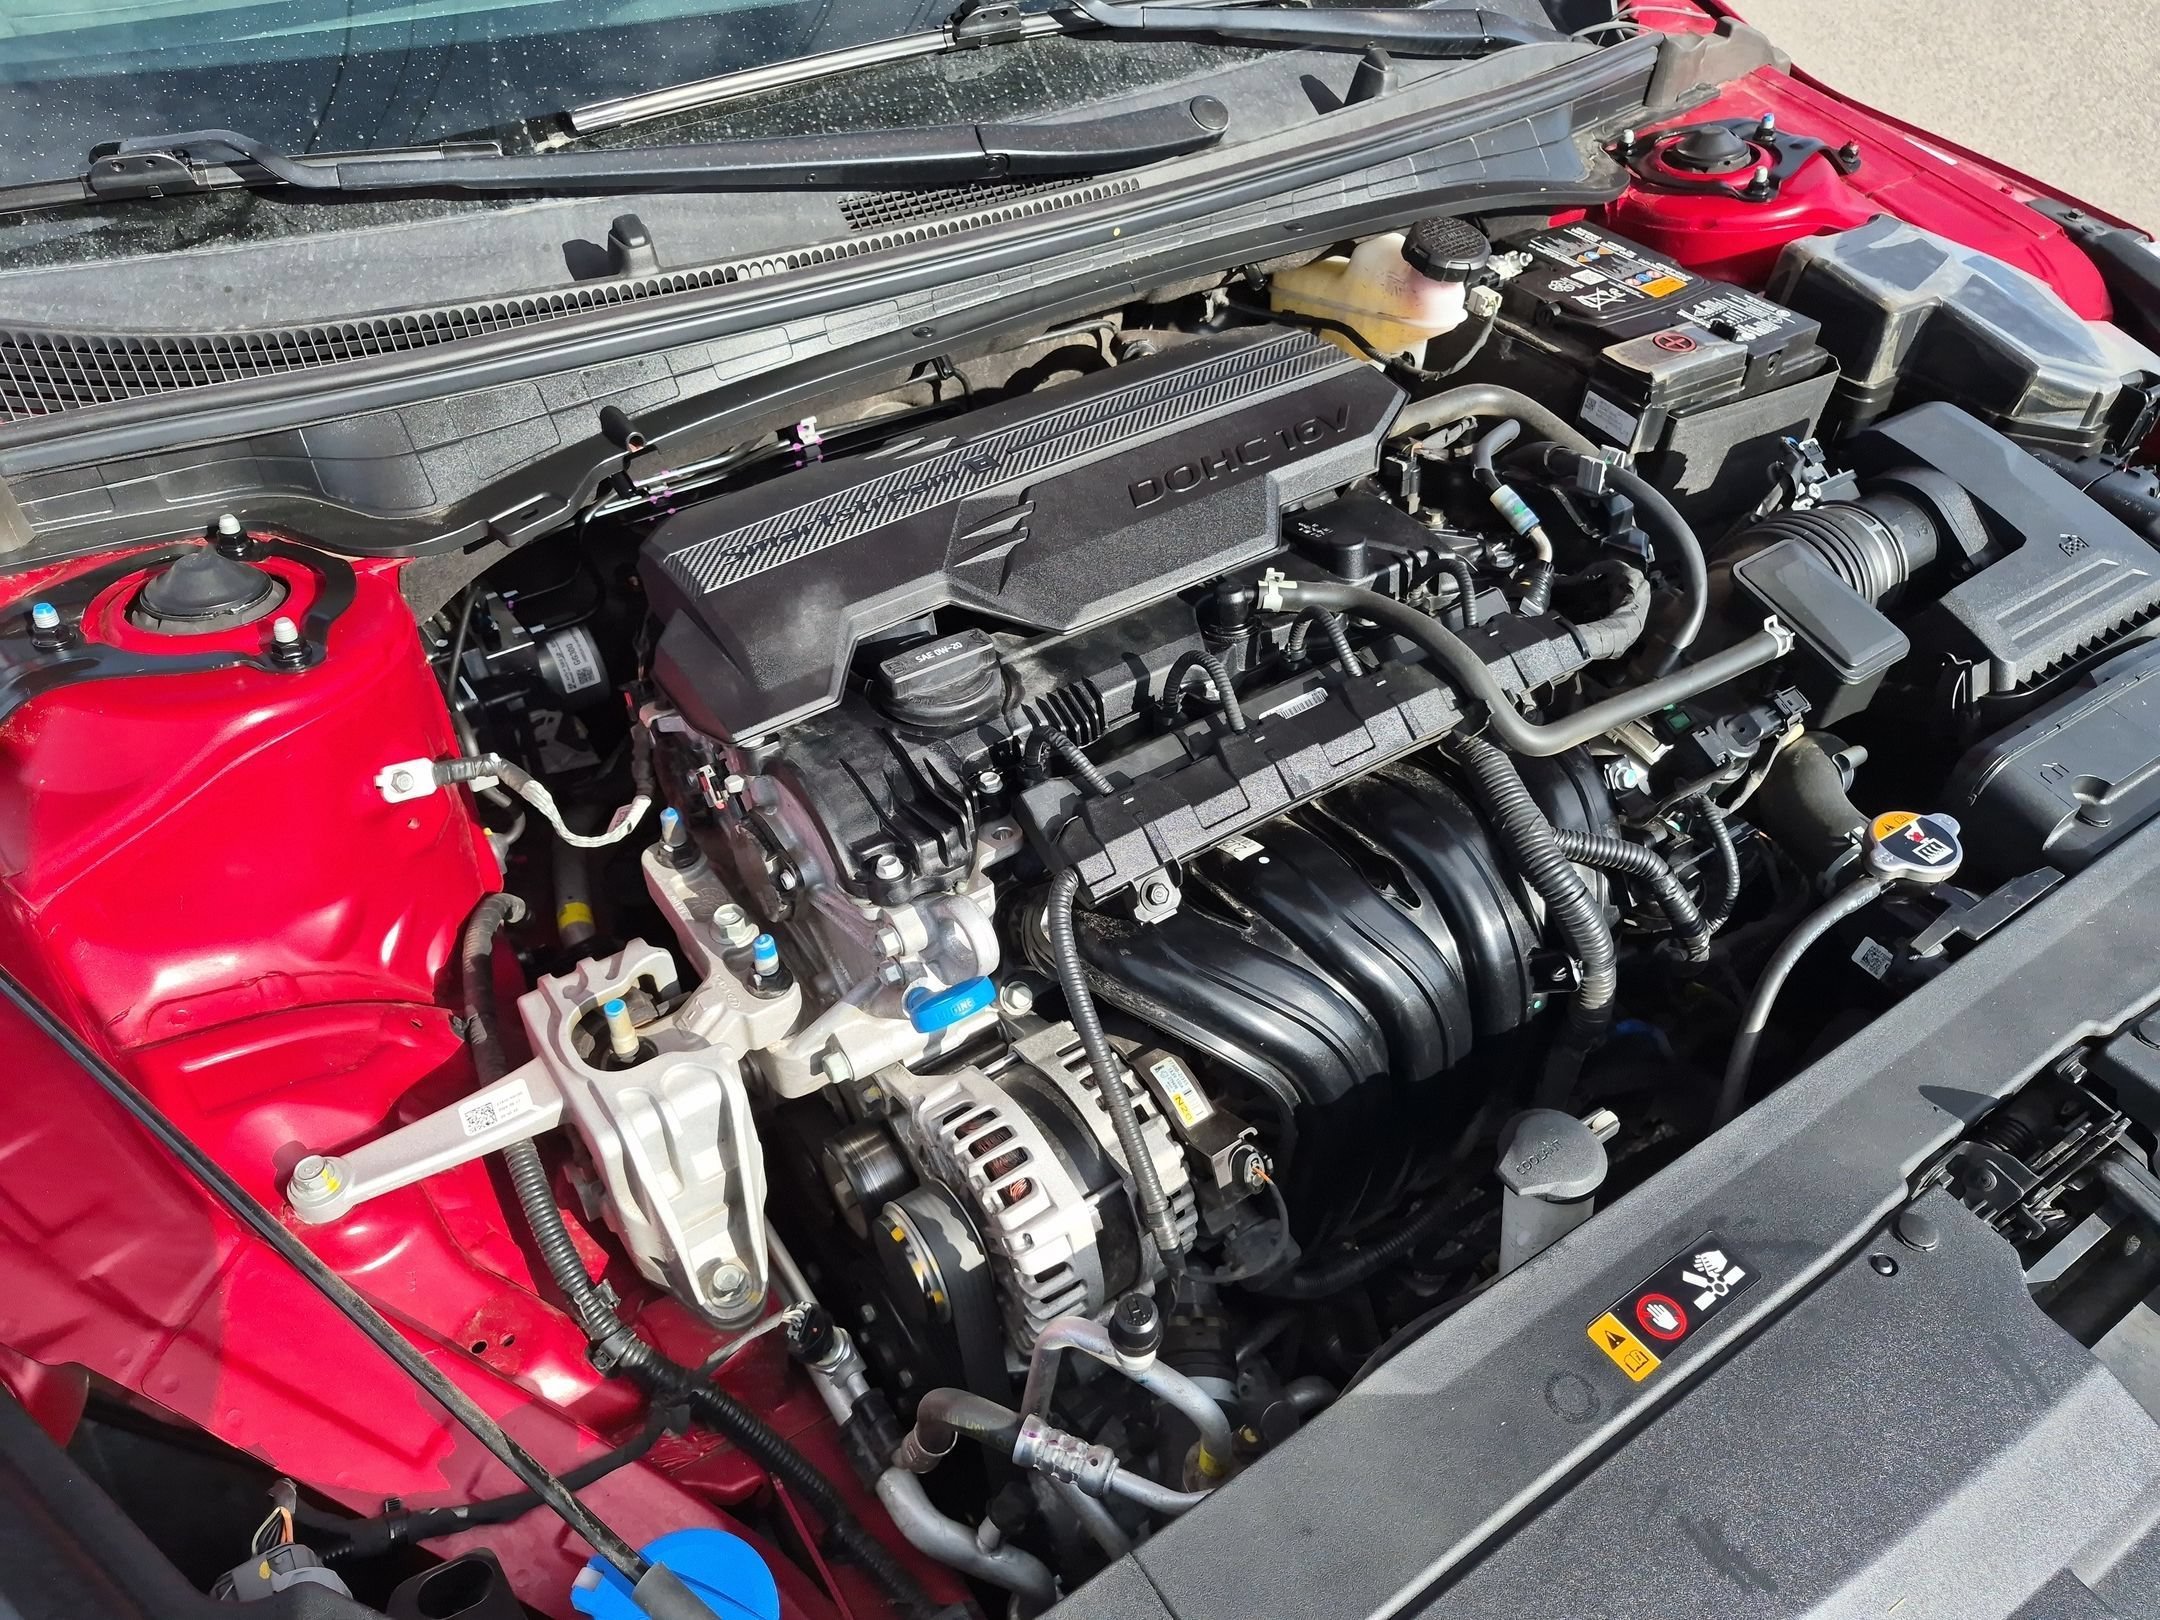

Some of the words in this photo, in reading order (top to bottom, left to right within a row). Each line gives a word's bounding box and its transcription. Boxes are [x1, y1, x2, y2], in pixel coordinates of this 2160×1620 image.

[1128, 437, 1272, 510] DOHC
[1274, 404, 1350, 451] 16V
[720, 469, 961, 565] Smartstream
[914, 652, 936, 663] SAE
[934, 641, 963, 657] 0W-20
